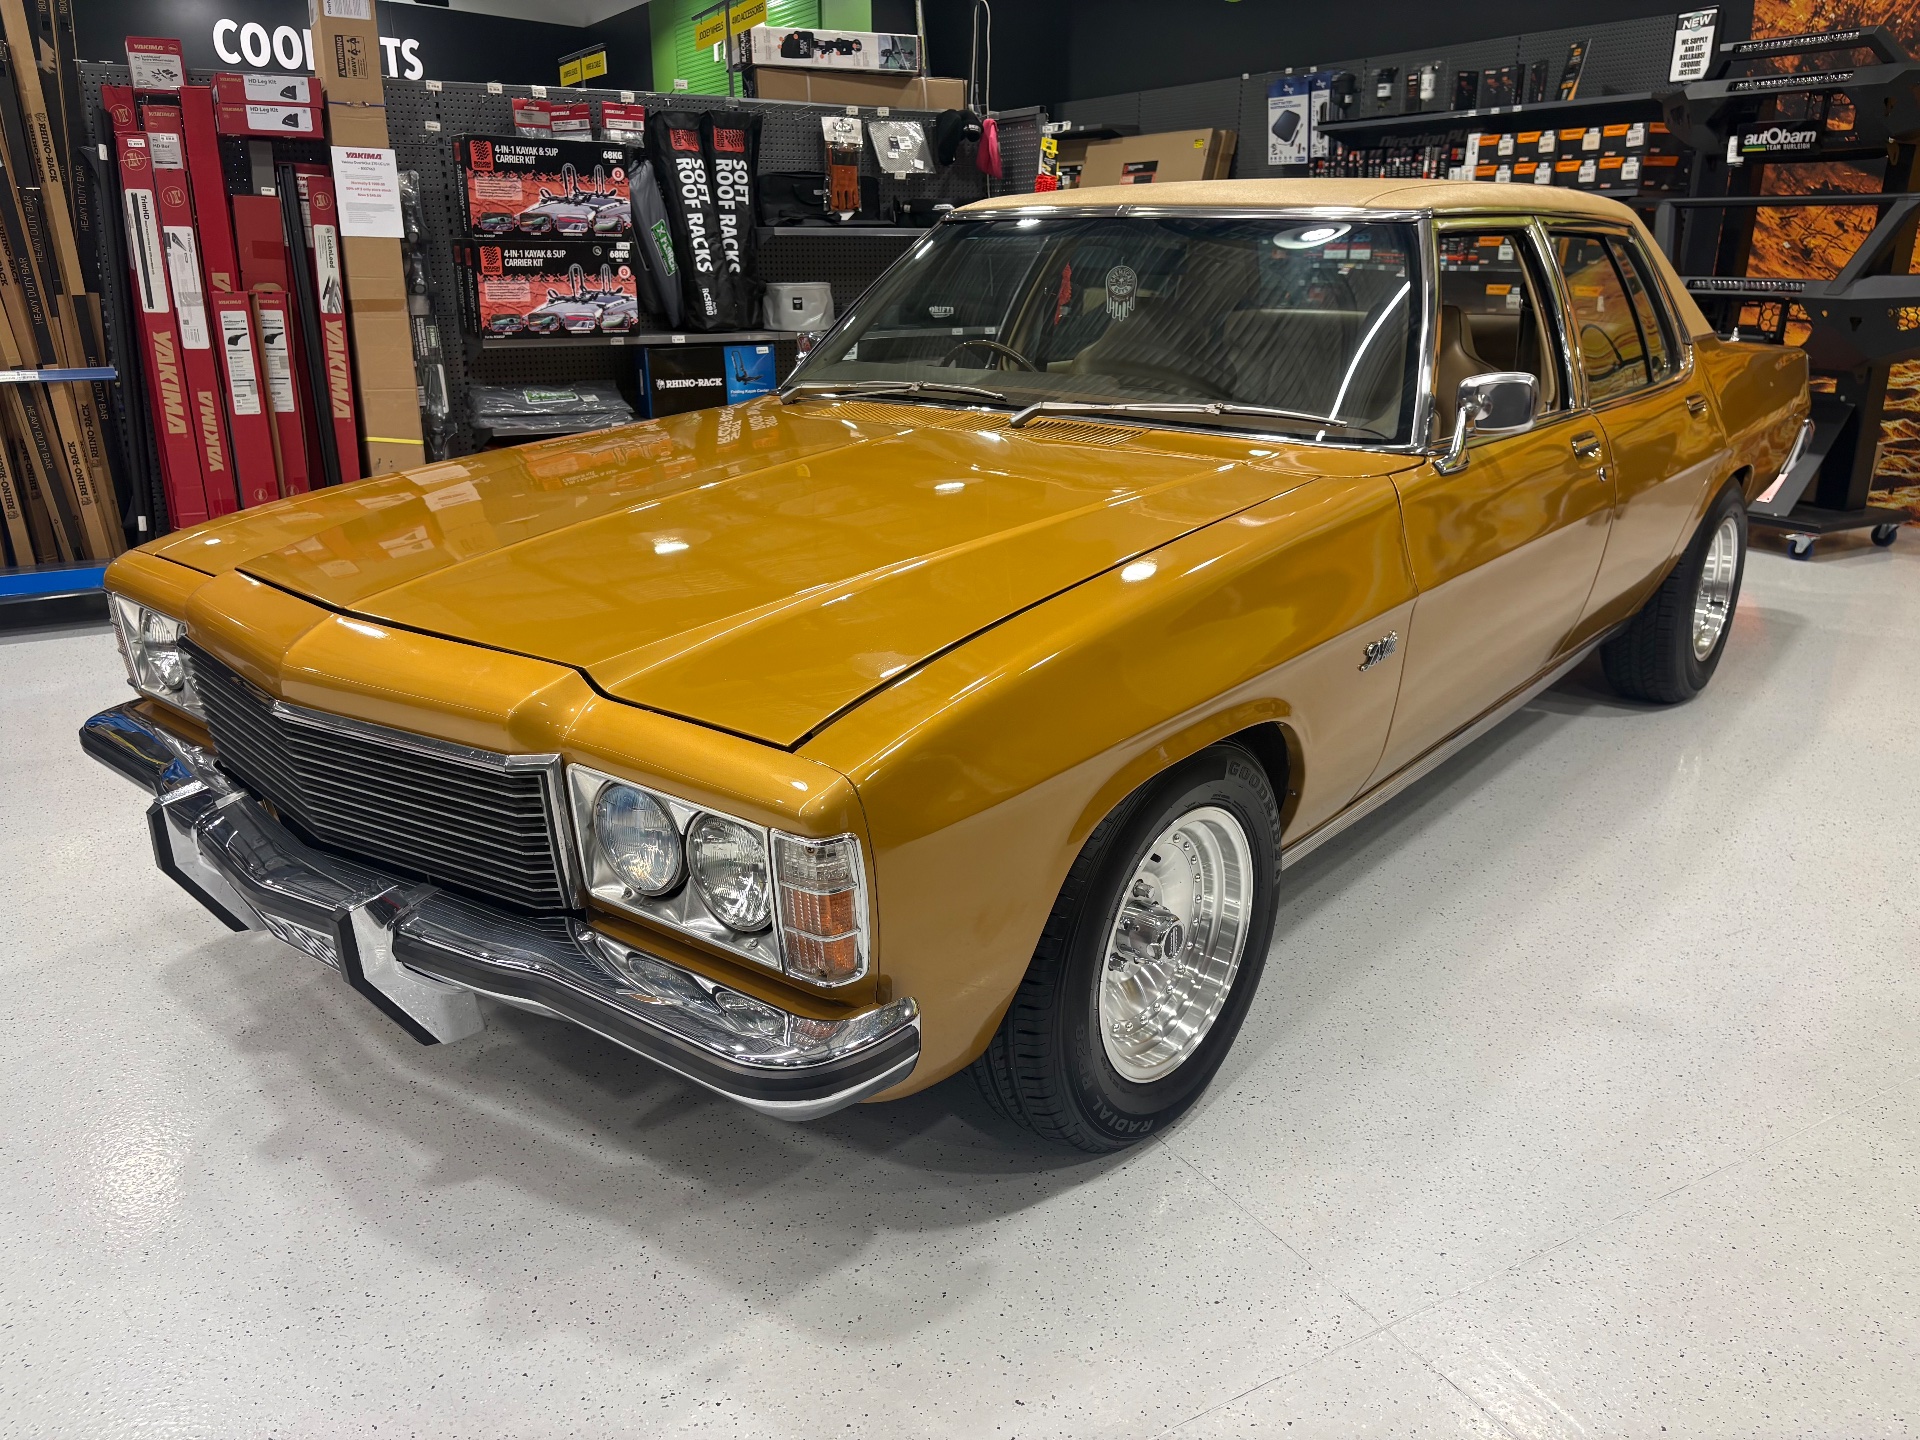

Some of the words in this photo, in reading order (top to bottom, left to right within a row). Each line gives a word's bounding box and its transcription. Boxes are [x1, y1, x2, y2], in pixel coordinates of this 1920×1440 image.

[1682, 14, 1712, 30] NEW
[336, 36, 345, 70] WARNING
[1681, 38, 1690, 46] WE
[1690, 36, 1708, 44] SUPPLY
[350, 56, 358, 77] HEAVY
[28, 124, 46, 183] RHINO-RACK
[38, 122, 58, 182] RHINO-RACK
[346, 152, 382, 160] YAKIMA
[494, 145, 514, 154] 4-IN-1
[516, 146, 538, 155] KAYAK
[545, 148, 558, 156] SUP
[496, 154, 524, 164] CARRIER
[525, 156, 536, 164] KIT
[602, 151, 623, 159] 68KG
[76, 165, 85, 182] BAR
[676, 158, 701, 208] ROOF
[692, 158, 710, 204] SOFT
[715, 160, 735, 210] ROOF
[733, 159, 749, 205] SOFT
[24, 195, 32, 212] BAR
[77, 184, 86, 209] DUTY
[140, 195, 149, 220] TrimHD
[28, 213, 40, 238] DUTY
[78, 208, 90, 232] HEAVY
[34, 238, 44, 263] HEAVY
[326, 235, 335, 269] LocknLoad
[504, 250, 523, 258] 4-IN-1
[524, 250, 546, 258] KAYAK
[547, 250, 552, 258] &
[609, 251, 629, 259] 68KG
[687, 213, 714, 272] RACKS
[0, 226, 20, 285] RHINO-RACK
[19, 257, 29, 274] BAR
[504, 258, 532, 266] CARRIER
[533, 258, 543, 266] KIT
[26, 275, 36, 299] DUTY
[31, 299, 43, 324] HEAVY
[702, 288, 713, 316] RCSR80
[325, 320, 350, 418] YAKIMA
[94, 382, 105, 404] DUTY
[152, 331, 187, 434] YAKIMA
[666, 378, 722, 388] RHINO-RACK
[99, 404, 108, 420] BAR
[26, 405, 40, 430] HEAVY
[35, 427, 47, 452] DUTY
[41, 448, 52, 470] BAR
[81, 404, 99, 459] RHINO-RACK
[197, 391, 224, 472] YAKIMA
[20, 438, 38, 491] RHINO-RACK
[67, 441, 88, 496] RHINO-RACK
[1092, 1095, 1153, 1132] RADIAL
